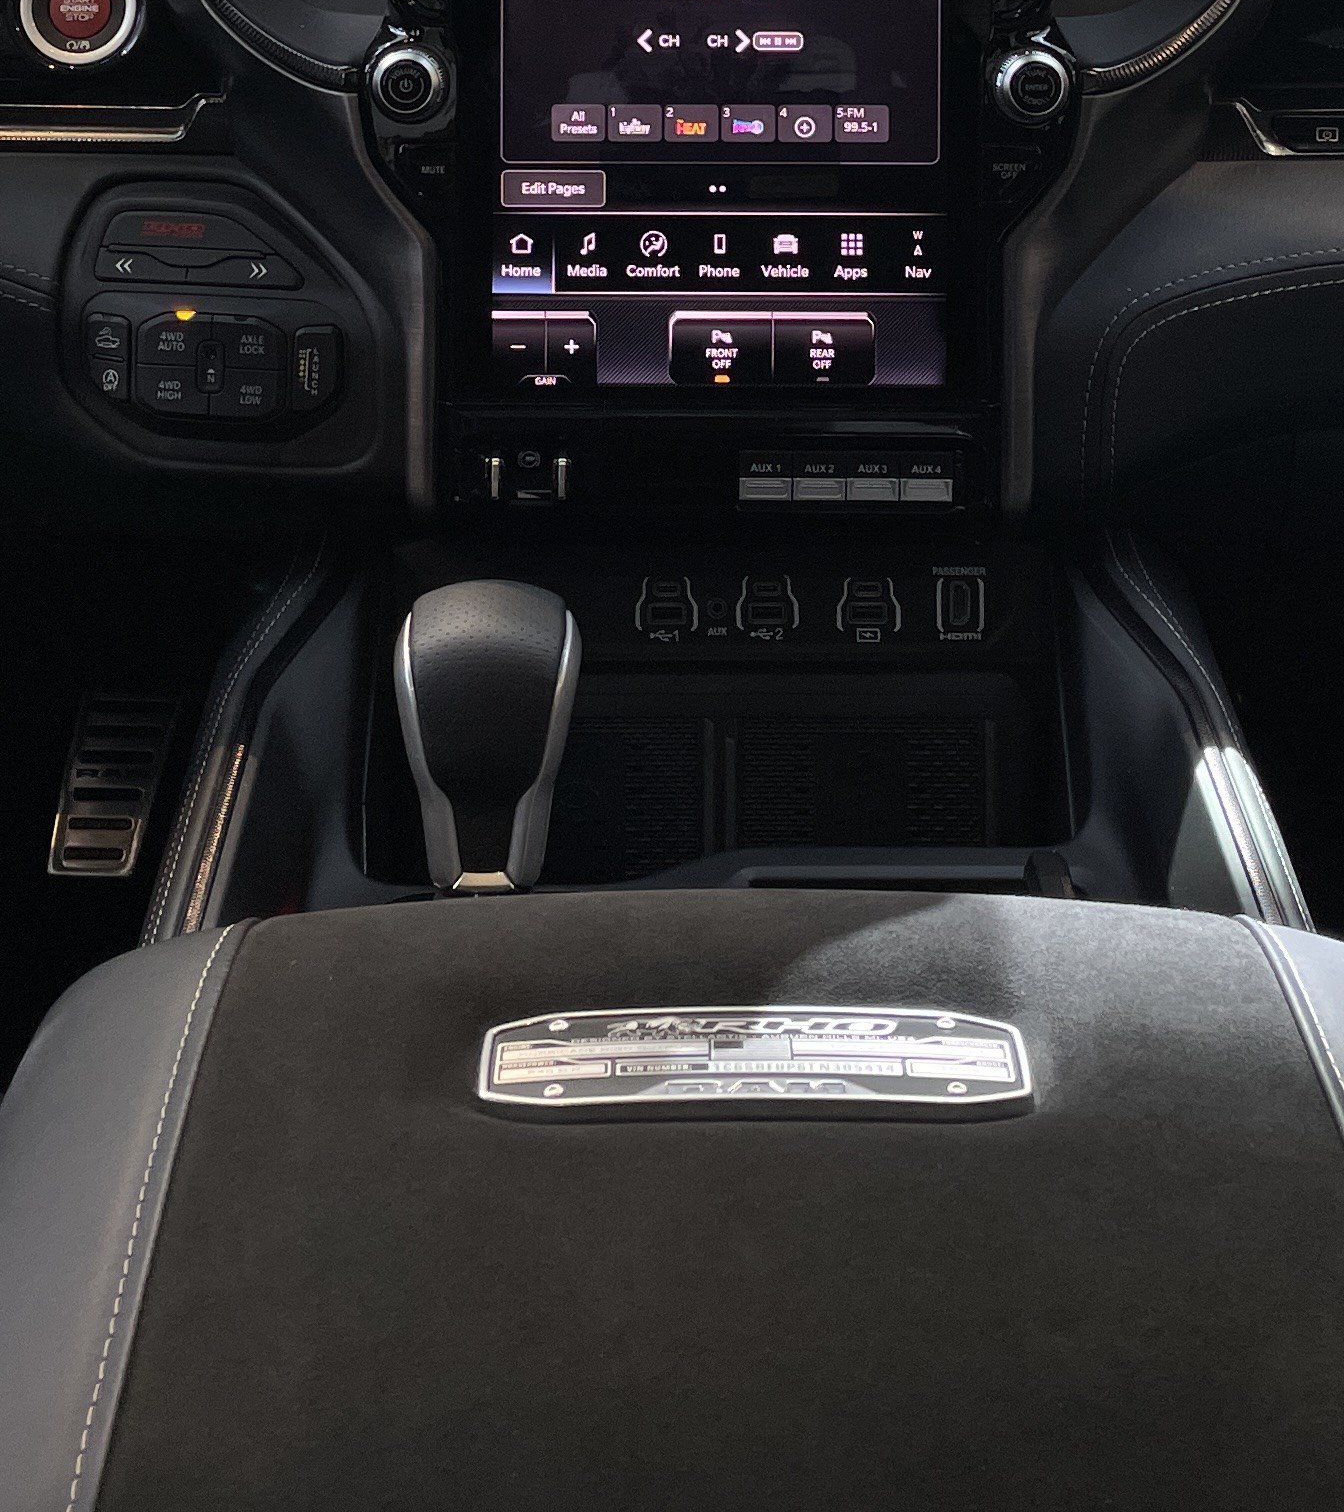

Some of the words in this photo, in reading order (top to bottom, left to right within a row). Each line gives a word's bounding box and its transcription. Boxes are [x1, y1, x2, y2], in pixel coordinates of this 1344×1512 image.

[658, 35, 680, 48] CH
[707, 35, 730, 48] CH
[570, 111, 585, 122] All
[610, 107, 616, 117] 1
[666, 107, 674, 118] 2
[722, 107, 731, 118] 3
[779, 107, 788, 118] 4
[836, 108, 865, 119] 5-FM
[560, 123, 598, 135] Presets
[843, 121, 878, 133] 99.5-1
[992, 162, 1026, 172] SCREEN
[521, 182, 545, 195] Edit
[546, 182, 586, 198] Pages
[501, 265, 541, 278] Home
[567, 264, 607, 278] Media
[626, 264, 680, 278] Comfort
[698, 264, 740, 278] Phone
[760, 264, 809, 278] Vehicle
[833, 264, 868, 281] Apps
[904, 266, 931, 279] Nav
[160, 331, 185, 343] 4WD
[240, 334, 265, 346] AXLE
[157, 340, 186, 352] AUTO
[239, 344, 265, 356] LOCK
[705, 348, 738, 359] FRONT
[809, 348, 835, 359] REAR
[711, 359, 732, 369] OFF
[812, 359, 832, 369] OFF
[310, 347, 320, 396] LAUNCH
[157, 380, 182, 391] 4WD
[534, 376, 557, 386] GAIN
[156, 389, 182, 400] HIGH
[240, 385, 263, 396] 4WD
[239, 394, 263, 405] LOW
[750, 463, 772, 475] AUX
[775, 463, 782, 474] 1
[804, 463, 826, 475] AUX
[827, 463, 836, 474] 2
[858, 463, 879, 475] AUX
[880, 463, 888, 474] 3
[911, 463, 932, 475] AUX
[933, 464, 942, 475] 4
[673, 629, 681, 642] 1
[707, 627, 729, 637] AUX
[774, 628, 785, 642] 2
[626, 1064, 644, 1073] VIN
